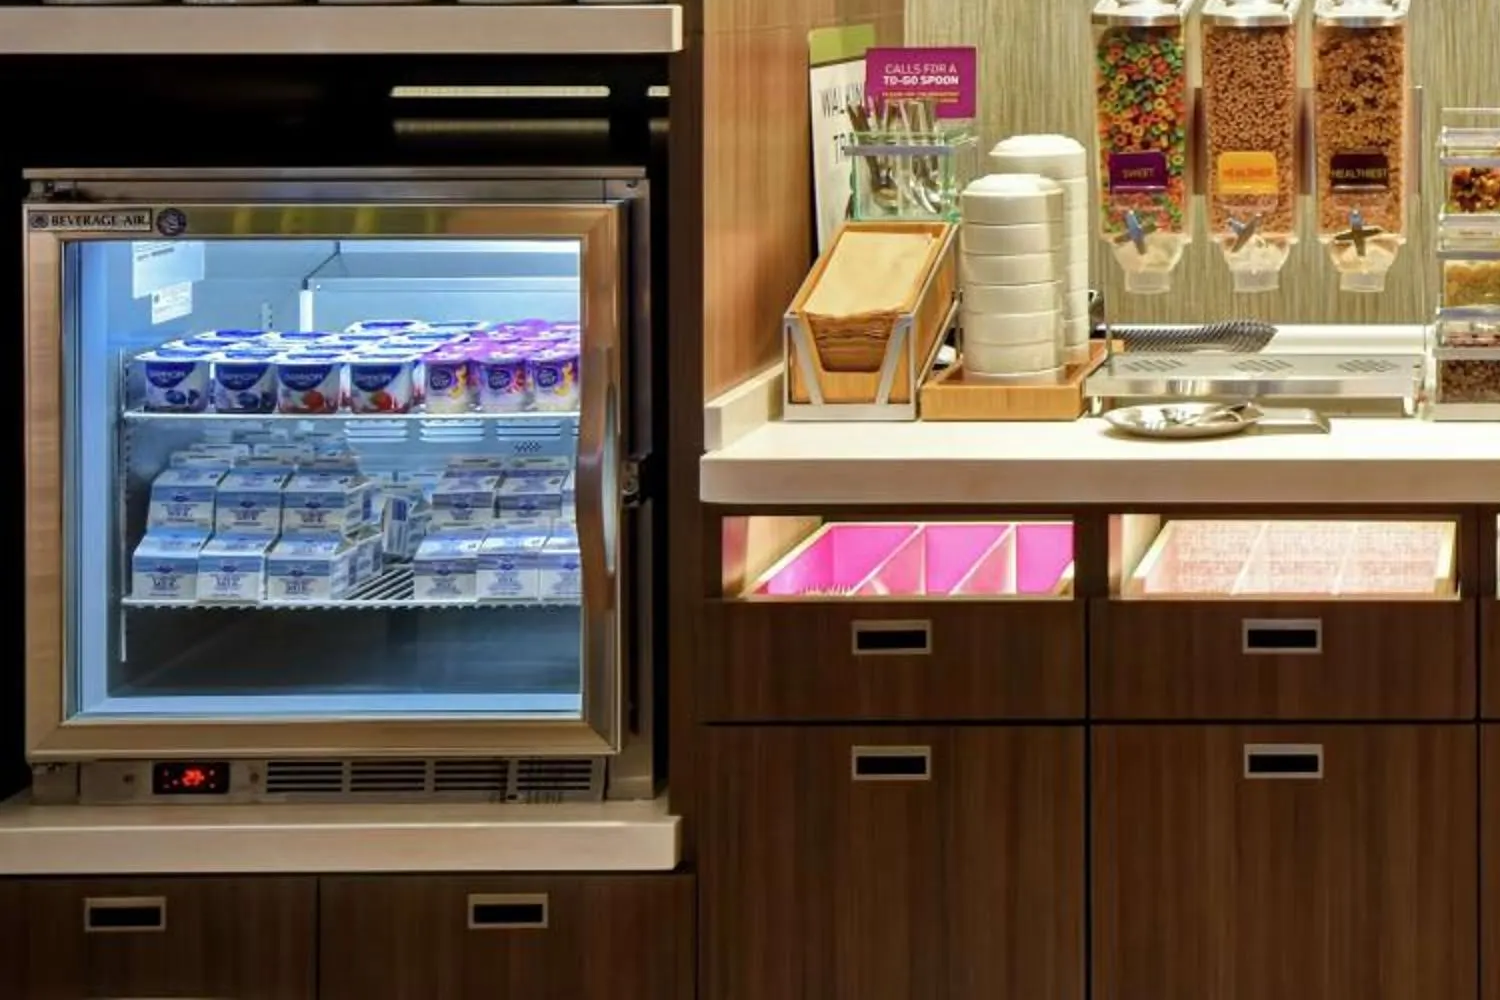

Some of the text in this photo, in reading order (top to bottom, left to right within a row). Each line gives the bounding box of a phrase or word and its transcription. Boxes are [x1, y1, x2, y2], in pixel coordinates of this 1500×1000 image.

[885, 63, 957, 74] CALLS FOR A
[883, 75, 960, 85] TO-GO SPOON
